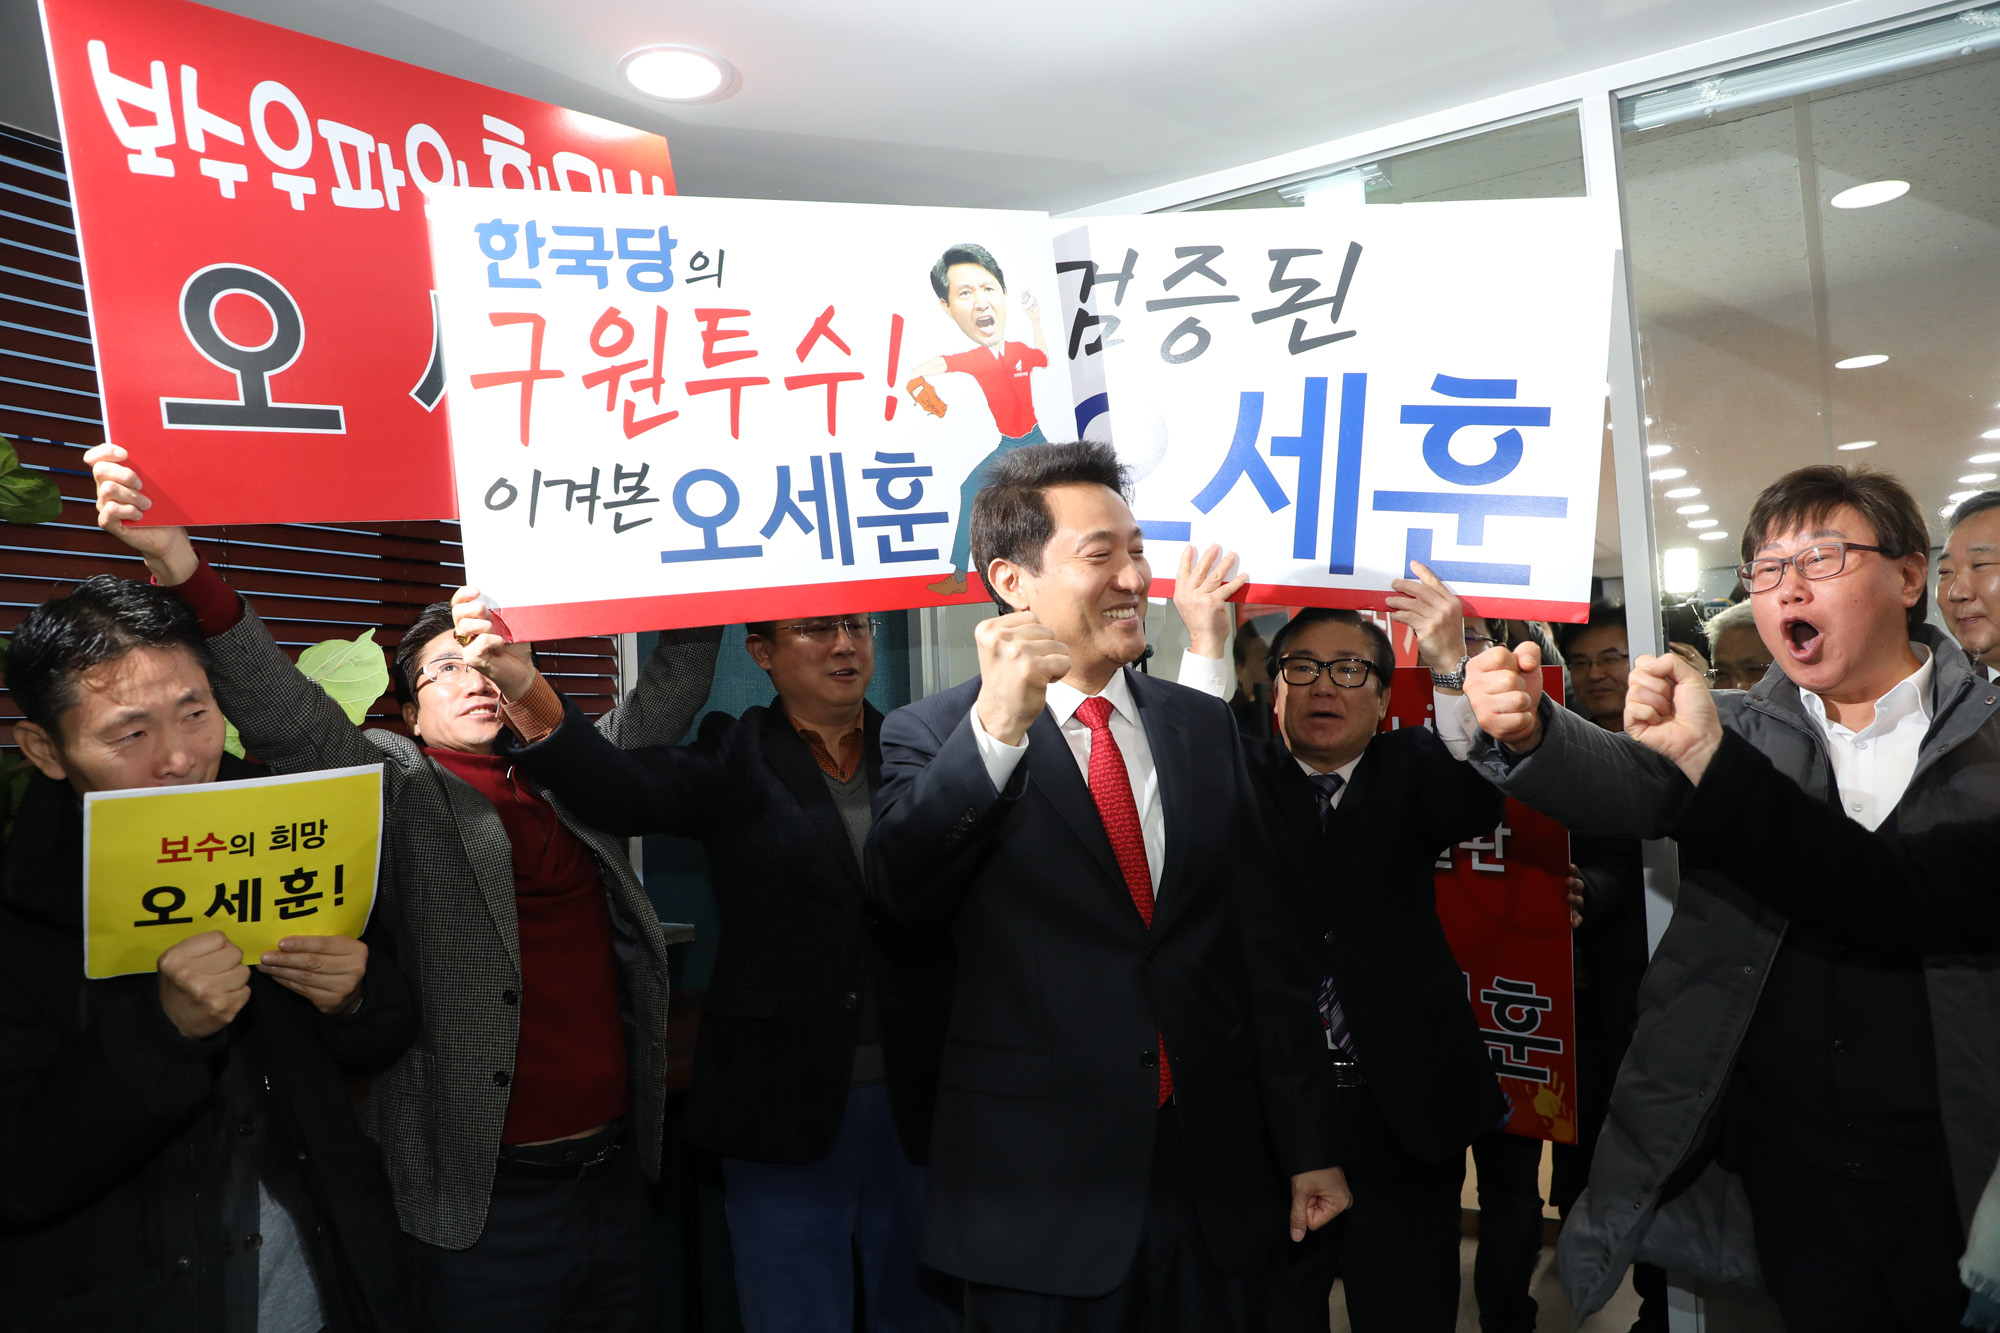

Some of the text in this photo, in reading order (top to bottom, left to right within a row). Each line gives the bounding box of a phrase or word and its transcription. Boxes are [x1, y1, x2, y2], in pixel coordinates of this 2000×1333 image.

[474, 218, 725, 292] 한국당의
[1056, 241, 1363, 364] 검증된
[470, 304, 905, 447] 구원투수!
[484, 451, 950, 566] 이겨본 오세훈
[157, 819, 328, 863] 보수의 희망
[133, 864, 344, 927] 오세훈!
